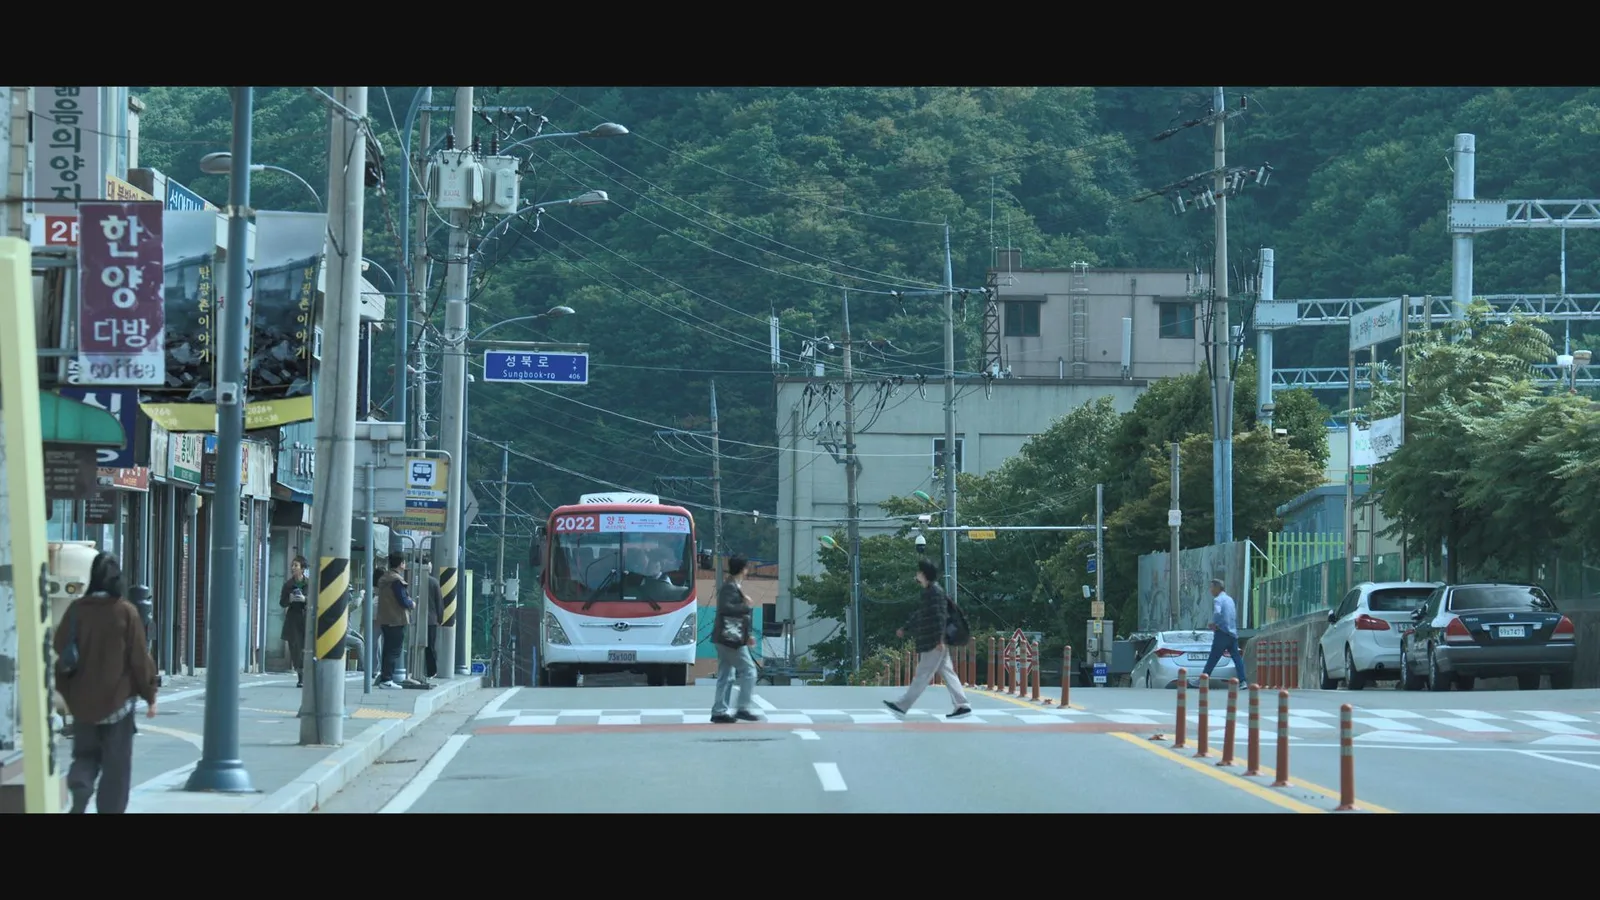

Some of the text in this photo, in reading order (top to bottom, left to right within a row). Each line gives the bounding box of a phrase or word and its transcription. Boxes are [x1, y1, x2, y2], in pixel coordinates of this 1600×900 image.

[94, 318, 150, 348] 다방
[505, 355, 549, 368] 성북로
[90, 360, 156, 380] coffee
[502, 369, 556, 380] Sungbook-ro
[568, 373, 581, 381] 406
[556, 516, 595, 531] 2022
